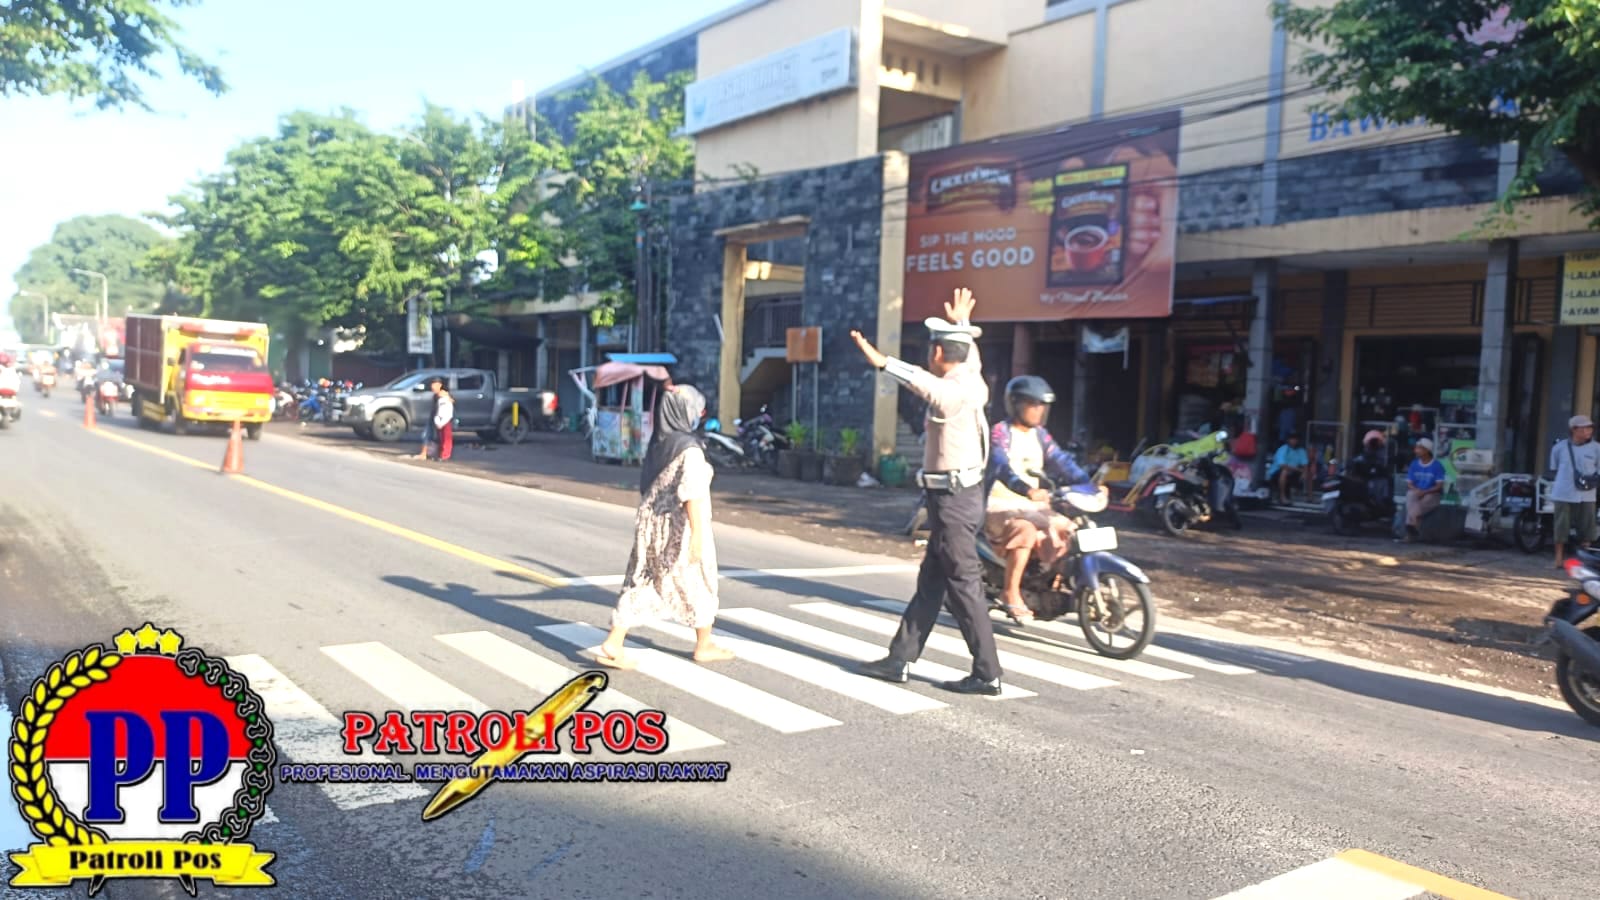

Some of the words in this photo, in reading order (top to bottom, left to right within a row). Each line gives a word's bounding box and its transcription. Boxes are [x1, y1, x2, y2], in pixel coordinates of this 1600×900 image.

[920, 234, 941, 248] SIP
[944, 231, 969, 245] THE
[973, 226, 1017, 244] MOOD
[905, 250, 965, 272] FEELS
[970, 245, 1036, 268] GOOD
